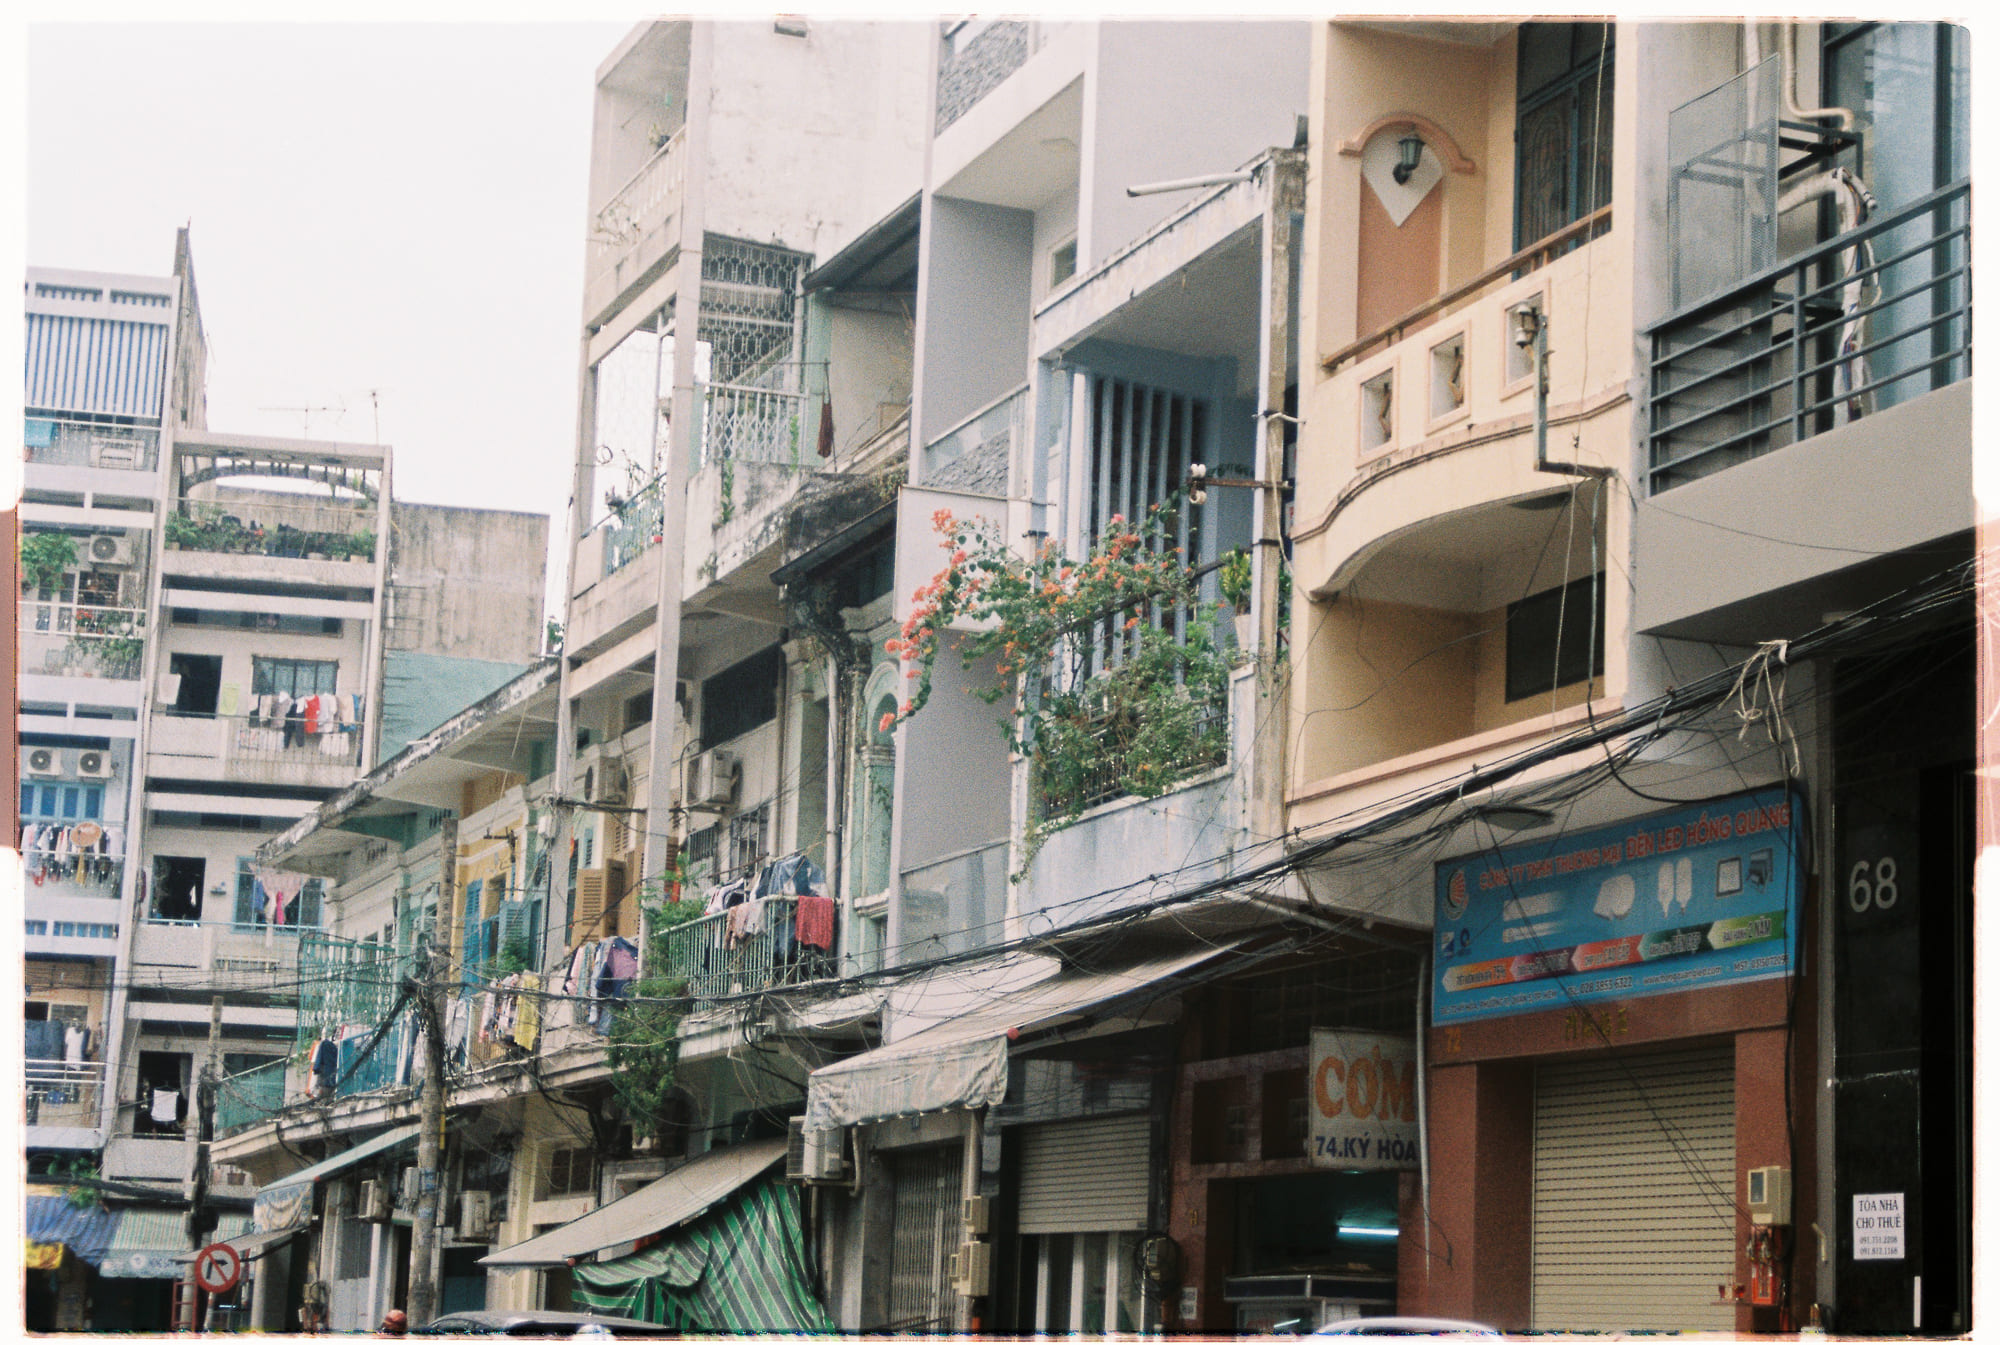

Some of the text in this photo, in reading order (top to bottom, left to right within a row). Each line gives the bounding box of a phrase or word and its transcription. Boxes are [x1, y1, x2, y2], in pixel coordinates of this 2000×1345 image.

[1657, 826, 1684, 854] LED
[1735, 802, 1790, 836] QUANG
[1849, 856, 1897, 912] 68
[1377, 1133, 1418, 1162] HÒA
[1856, 1217, 1875, 1229] CHO
